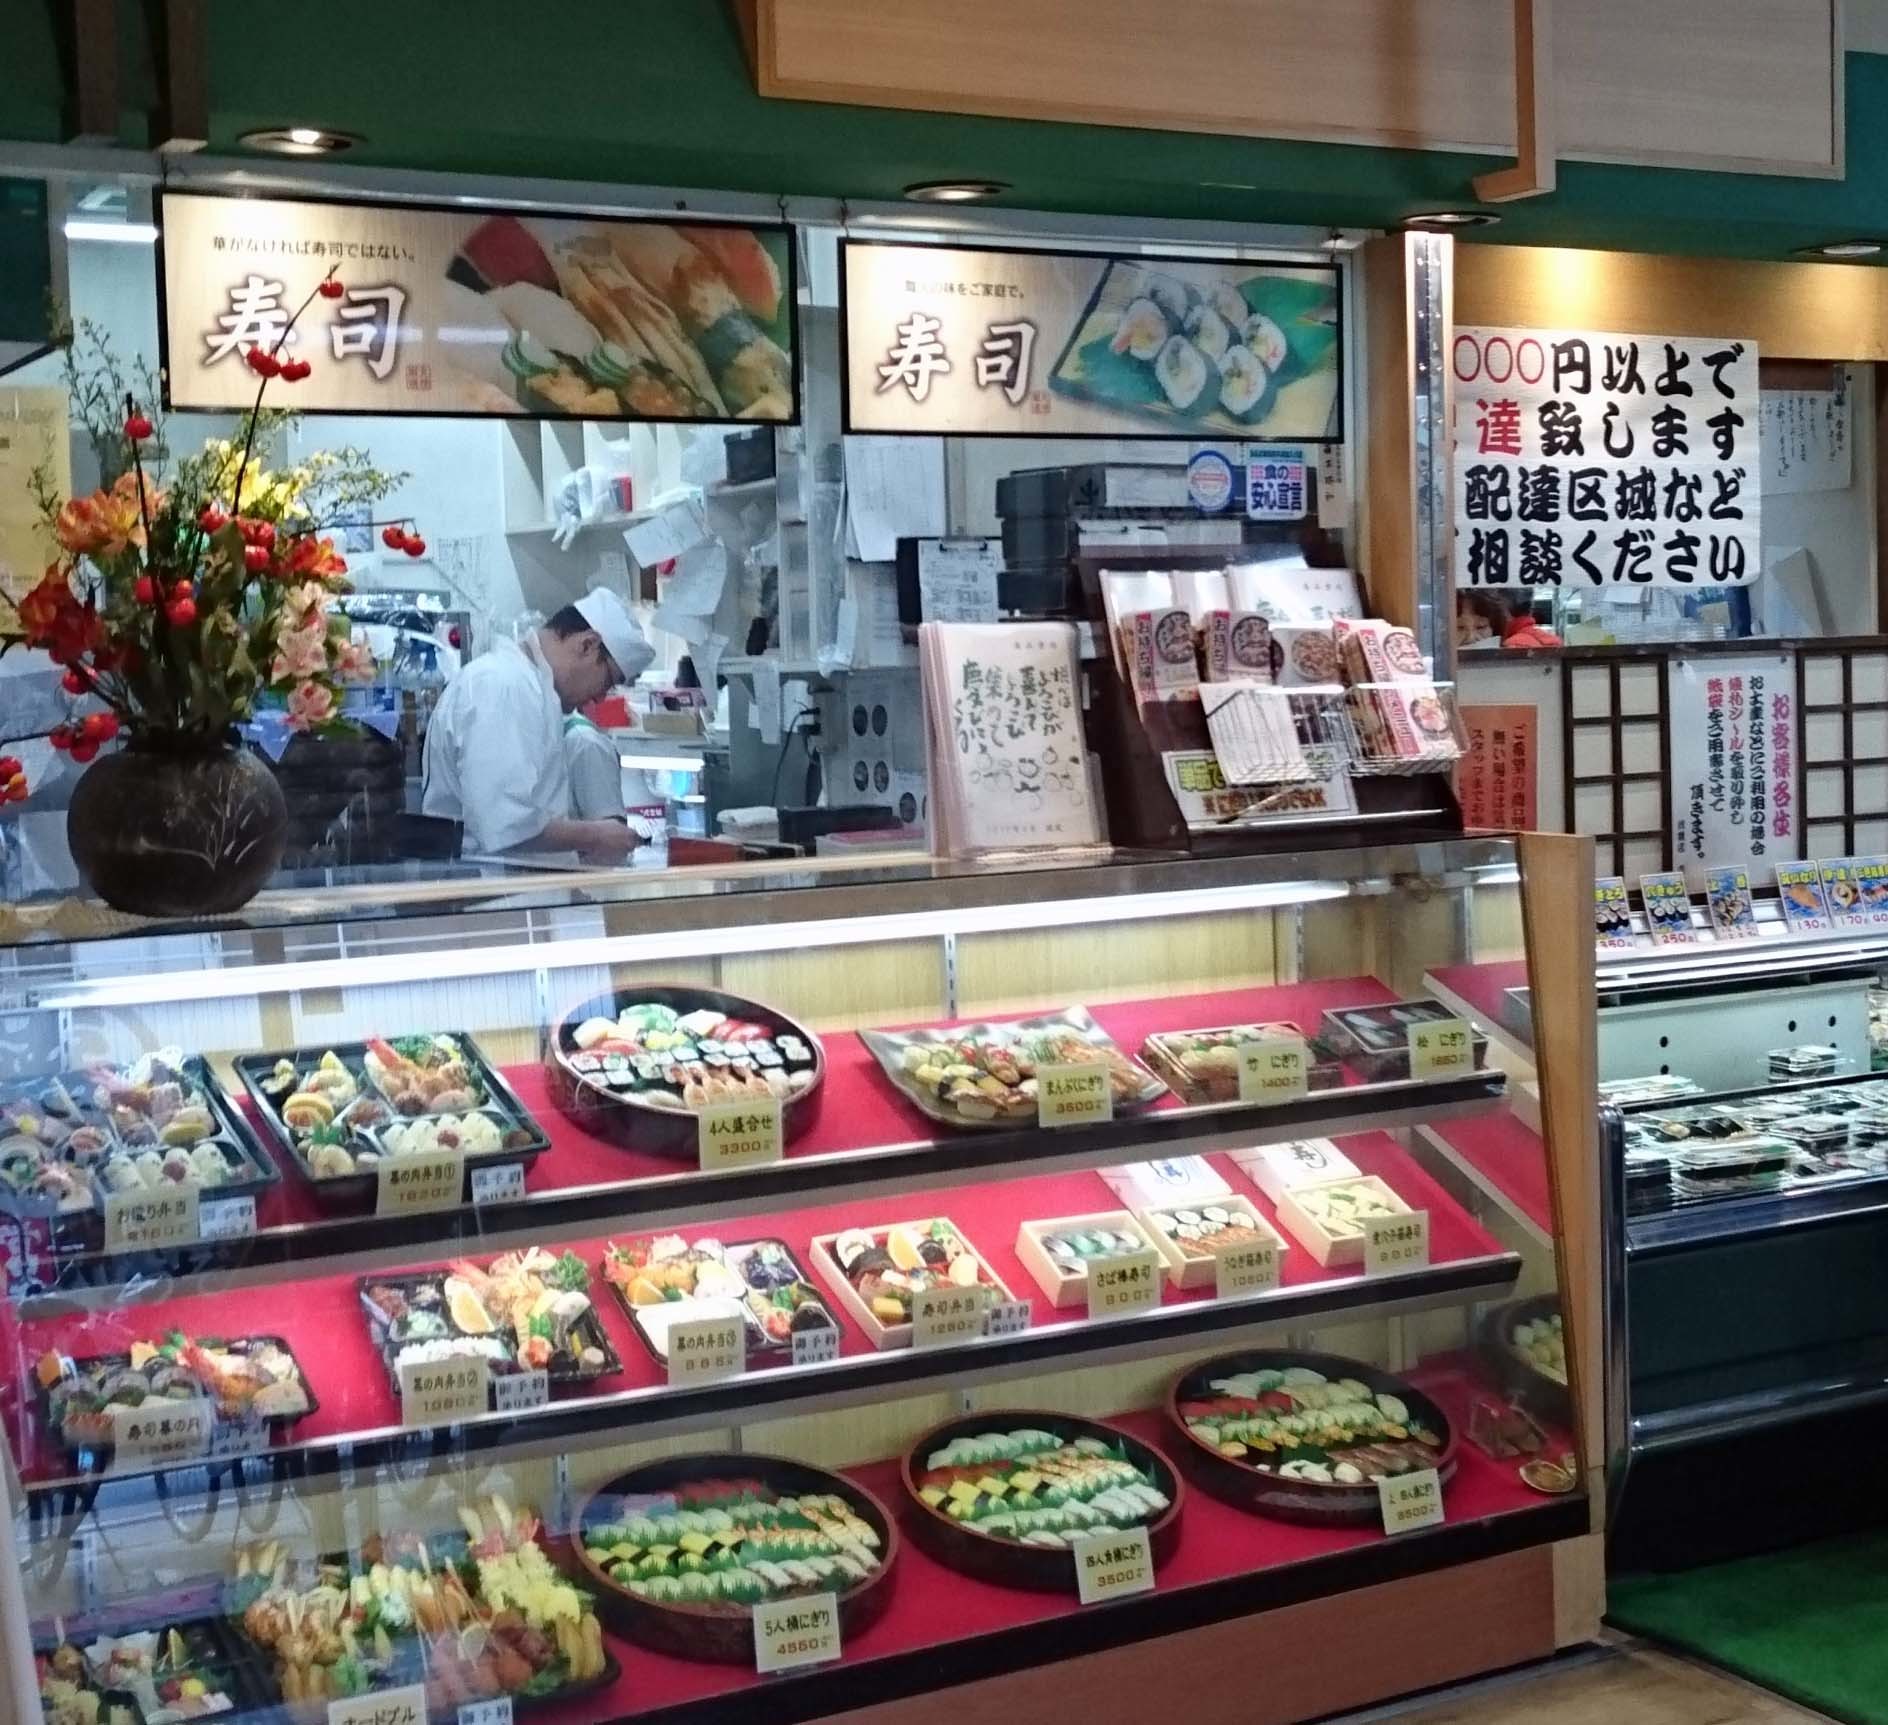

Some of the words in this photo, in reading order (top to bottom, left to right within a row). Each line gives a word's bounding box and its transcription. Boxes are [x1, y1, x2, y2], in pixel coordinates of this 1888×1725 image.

[213, 236, 415, 262] 華がなければ寿司ではない。
[203, 275, 406, 379] 寿司
[877, 311, 1037, 406] 寿司
[1453, 398, 1745, 460] 達致します
[1465, 464, 1745, 522] 配達区域など
[1454, 526, 1746, 585] 相談ください
